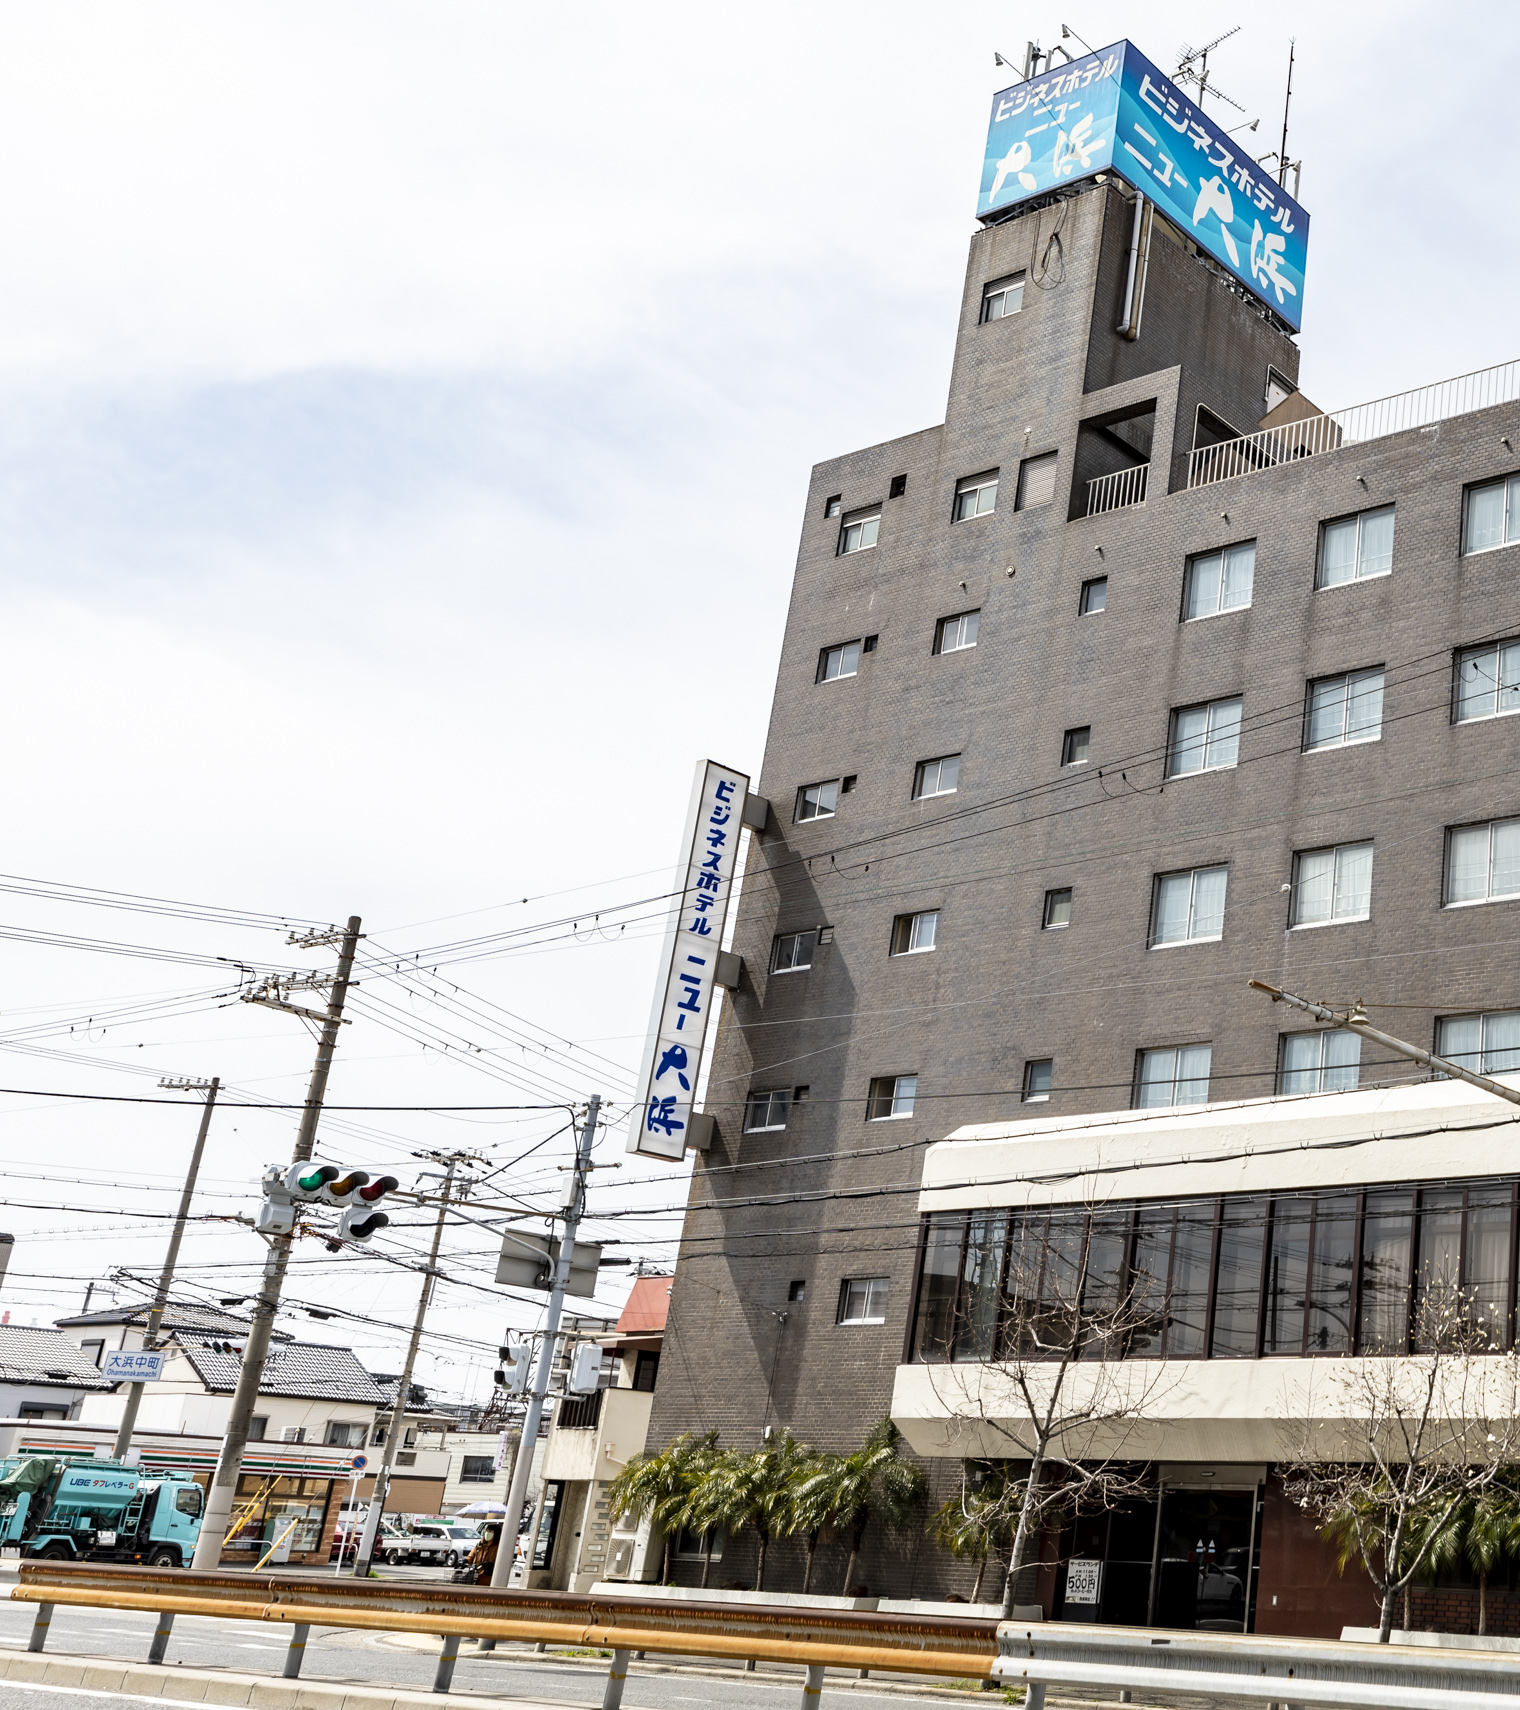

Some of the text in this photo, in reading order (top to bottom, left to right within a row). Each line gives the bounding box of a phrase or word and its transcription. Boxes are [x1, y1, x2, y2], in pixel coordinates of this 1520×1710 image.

[994, 53, 1119, 123] ビジネスホテル
[1025, 101, 1081, 138] ニュー
[1138, 73, 1295, 234] ビジネスホテル
[688, 780, 736, 937] ビジネスホテル
[108, 1355, 160, 1369] 大浜中町
[70, 1478, 91, 1487] UBE
[1067, 1575, 1096, 1590] 500円
